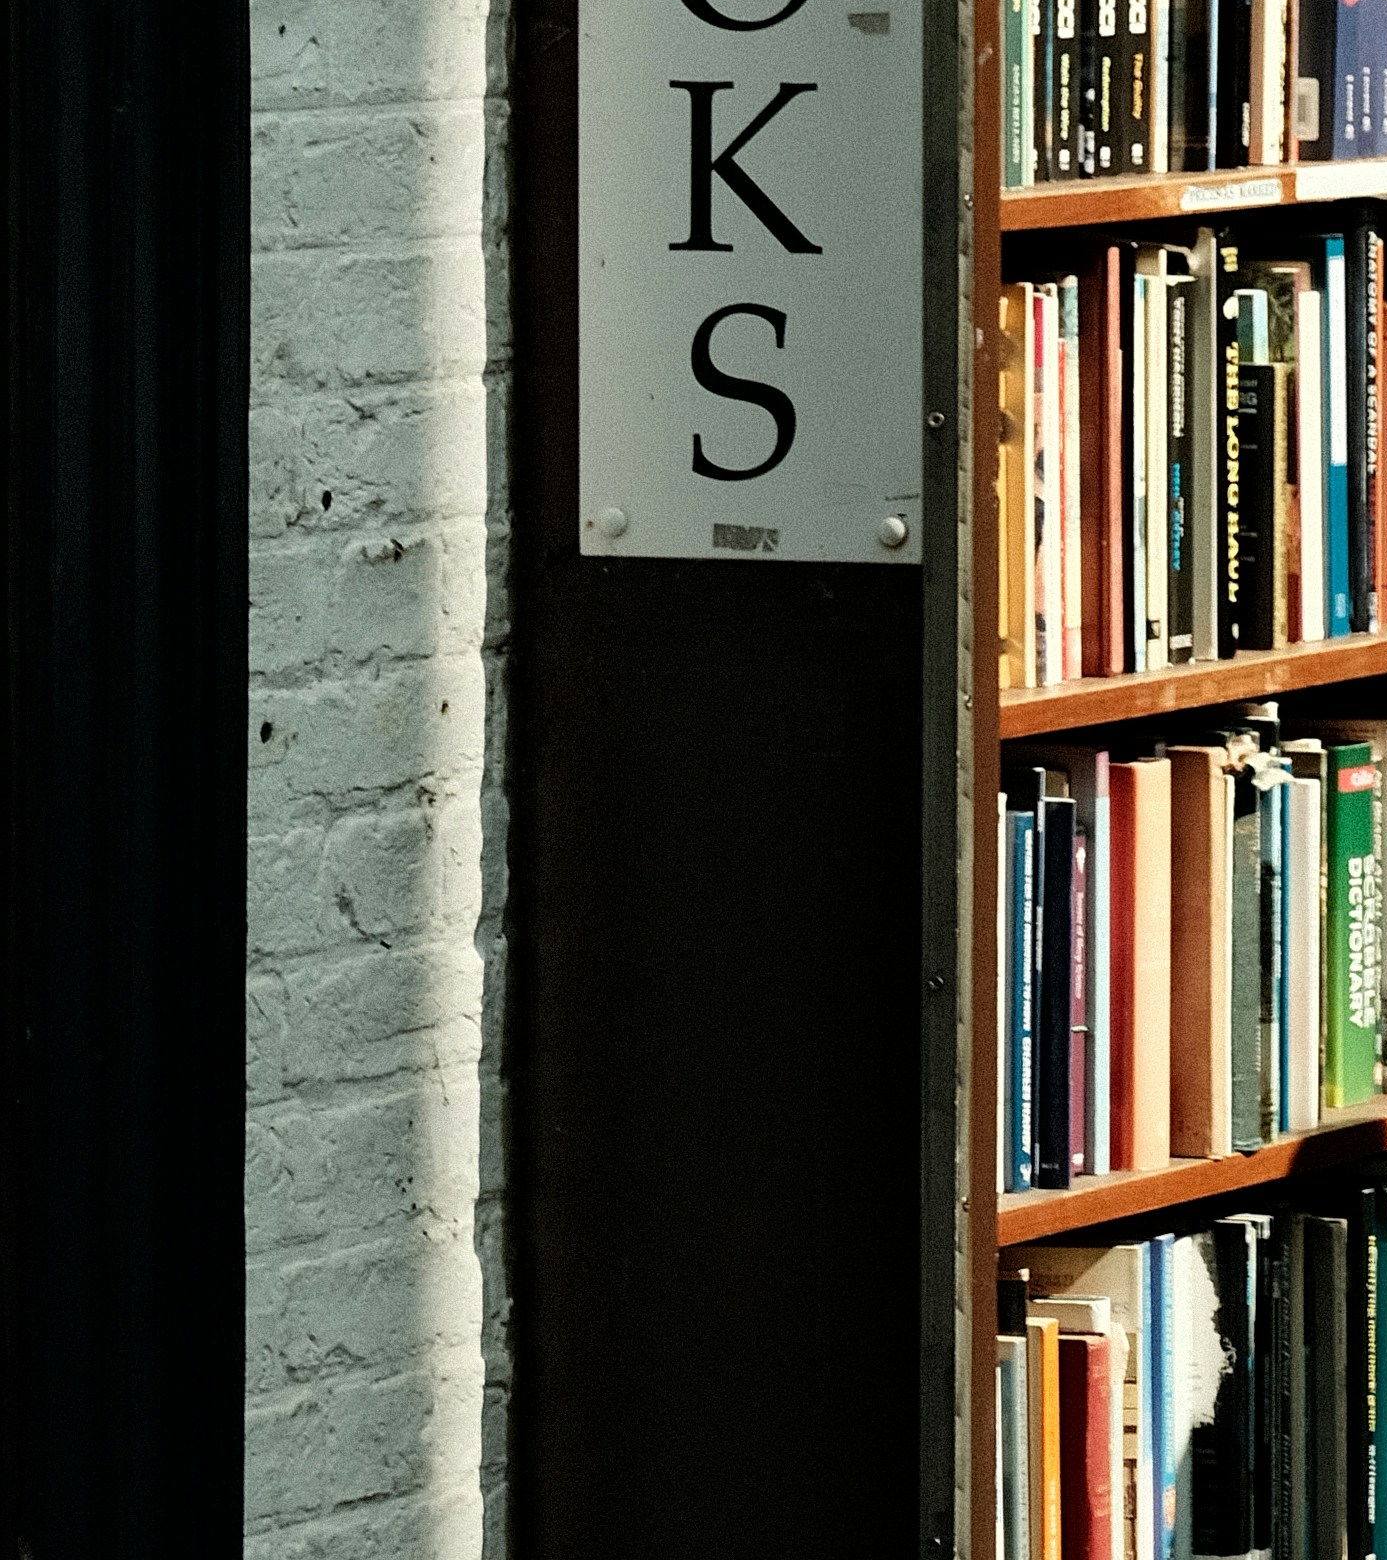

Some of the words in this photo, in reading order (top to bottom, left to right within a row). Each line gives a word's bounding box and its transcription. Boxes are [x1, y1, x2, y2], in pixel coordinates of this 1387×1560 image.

[1132, 52, 1144, 77] The
[1226, 342, 1239, 410] THE
[1226, 415, 1240, 507] LONG
[1366, 384, 1376, 474] SCANDAL
[1228, 511, 1240, 603] HAUL
[1348, 856, 1363, 1029] DICTIONARY
